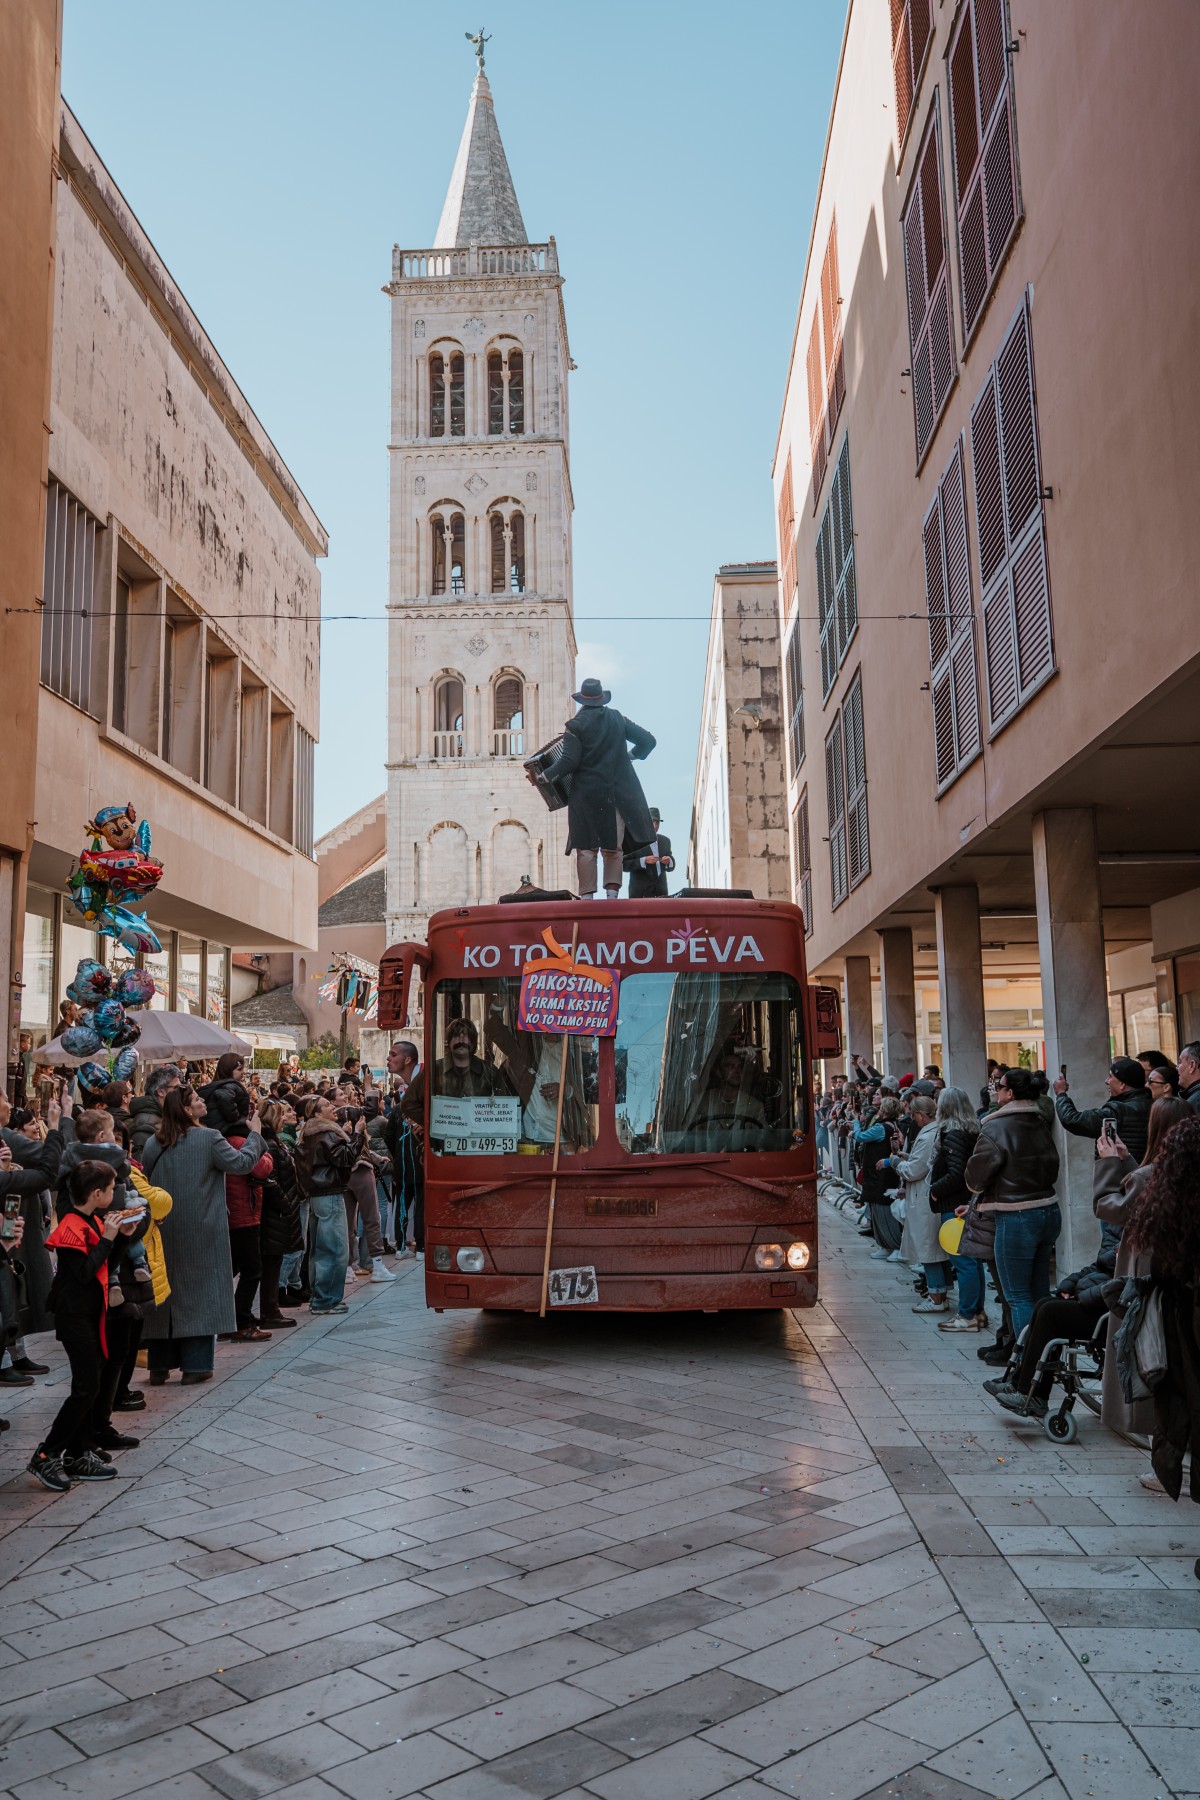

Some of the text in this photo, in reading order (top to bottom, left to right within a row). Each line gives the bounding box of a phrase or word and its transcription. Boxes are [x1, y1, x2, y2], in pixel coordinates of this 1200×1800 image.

[463, 945, 500, 968] KO
[509, 943, 547, 967] TO
[666, 935, 764, 964] PEVA
[529, 996, 611, 1013] FIRMA KRSTIĆ
[525, 1013, 608, 1028] KO TO TAMO PEVA
[456, 1138, 467, 1151] ZD
[478, 1138, 514, 1151] 499-53
[551, 1271, 595, 1301] 475
